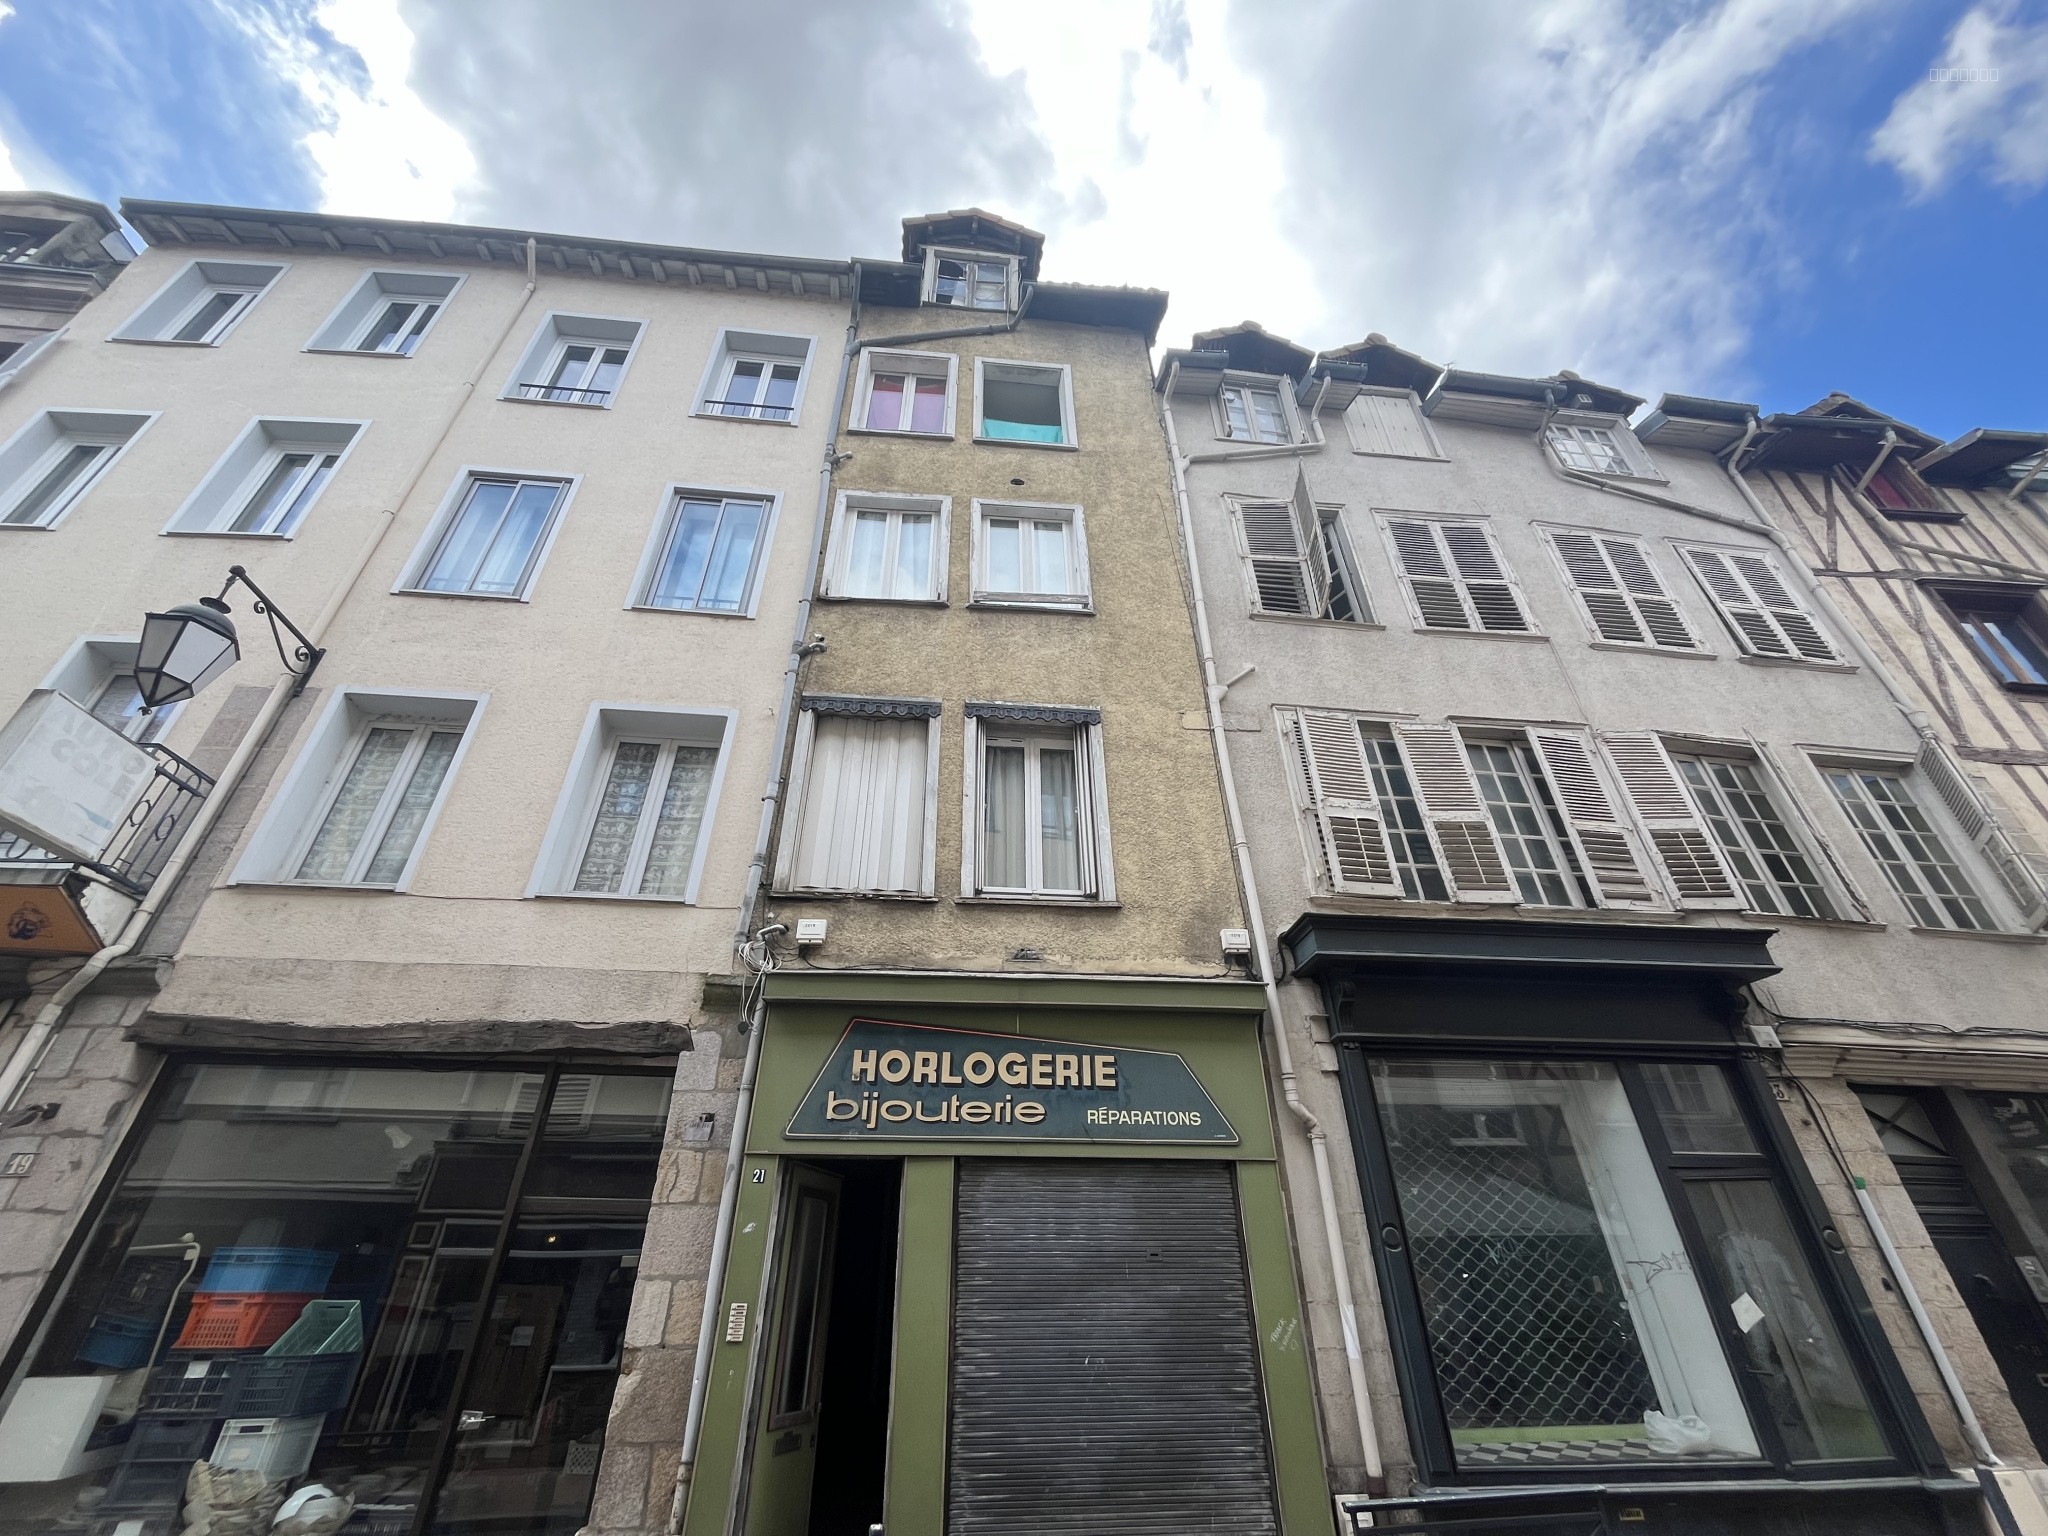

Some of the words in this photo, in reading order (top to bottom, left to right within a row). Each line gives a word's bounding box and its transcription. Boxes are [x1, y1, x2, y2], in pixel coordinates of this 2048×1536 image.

[852, 1050, 1117, 1087] HORLOGERIE
[826, 1090, 1046, 1129] bijouterie
[1087, 1106, 1202, 1126] RÉPARATIONS
[5, 1154, 35, 1174] 19
[752, 1168, 766, 1183] 21
